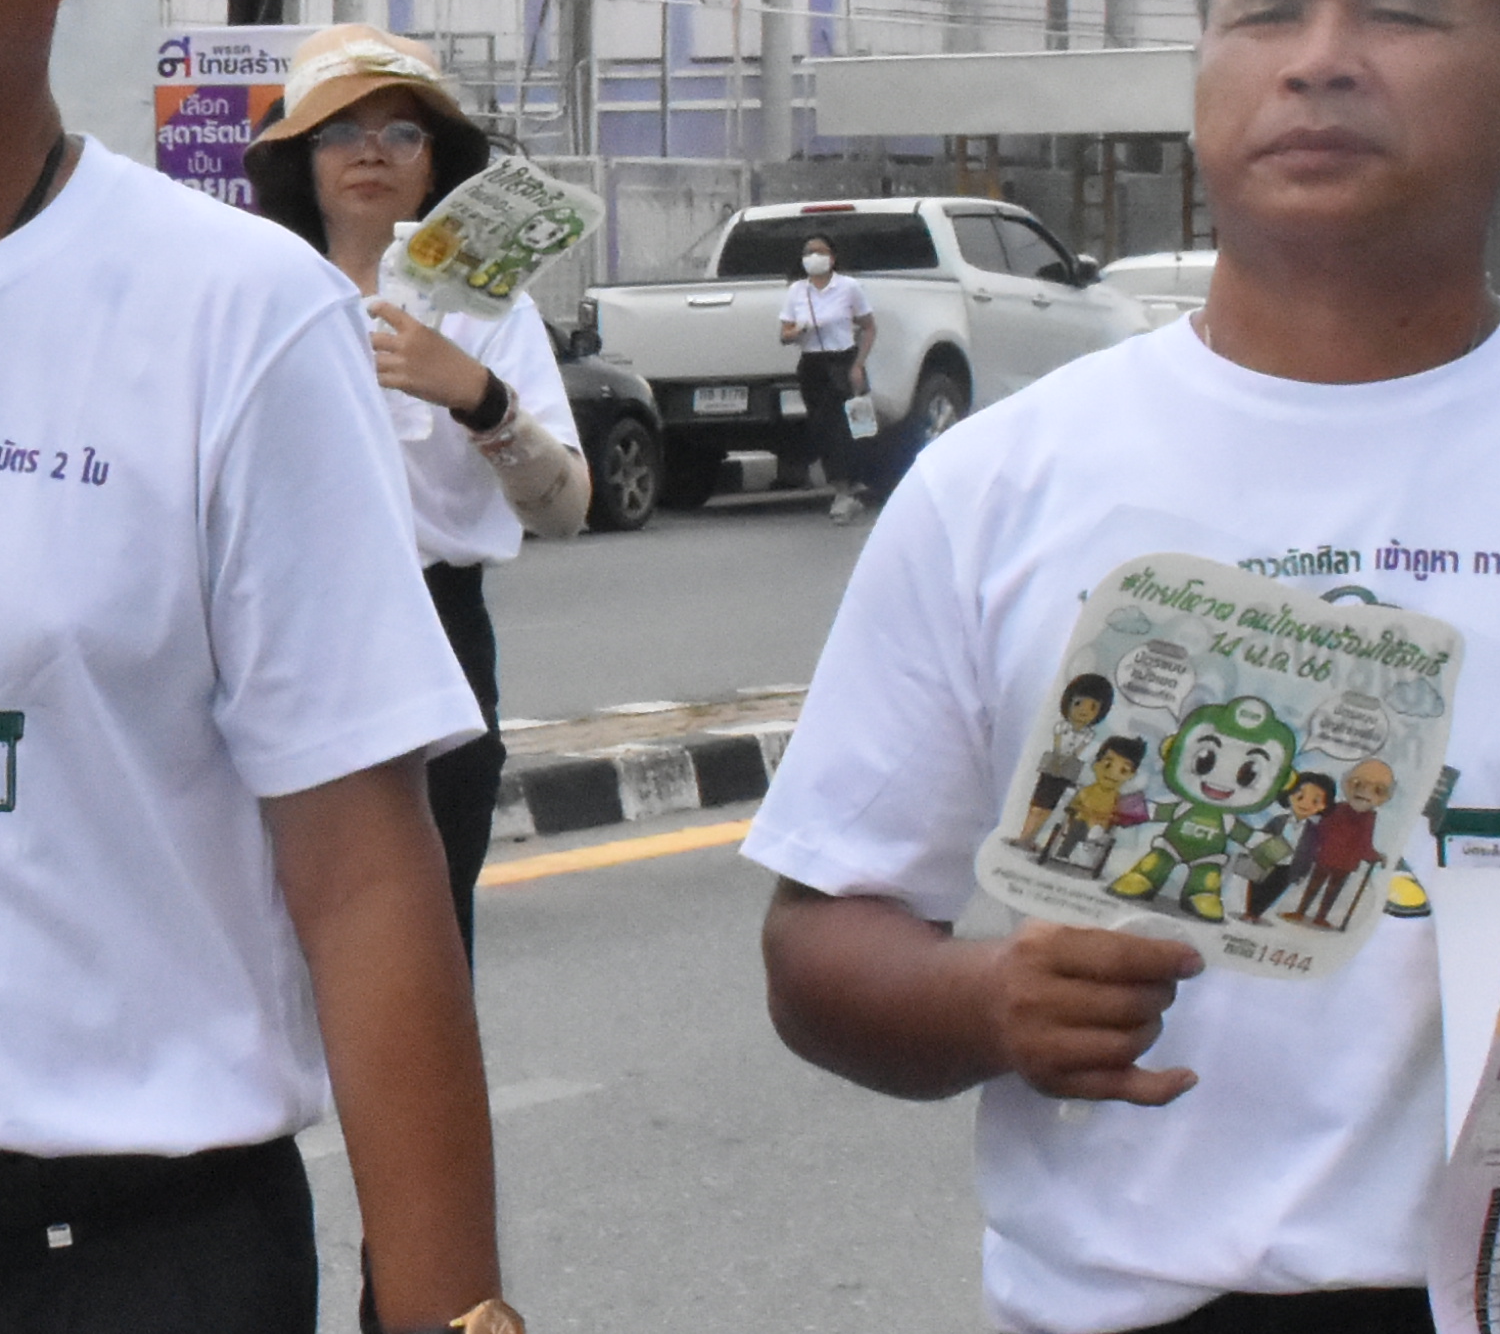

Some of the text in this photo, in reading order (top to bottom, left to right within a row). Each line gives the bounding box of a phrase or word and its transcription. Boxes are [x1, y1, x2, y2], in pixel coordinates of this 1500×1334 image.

[213, 45, 252, 56] พรรค
[179, 93, 229, 116] เลือก
[158, 119, 252, 151] สุดารัตน์
[188, 151, 222, 174] เป็น
[174, 177, 253, 205] ายก
[49, 451, 69, 480] 2
[81, 446, 110, 486] ใบ
[1375, 539, 1459, 581] เข้าคูหา
[1208, 631, 1244, 658] 14
[1297, 655, 1332, 683] 66
[1258, 944, 1314, 973] 1444
